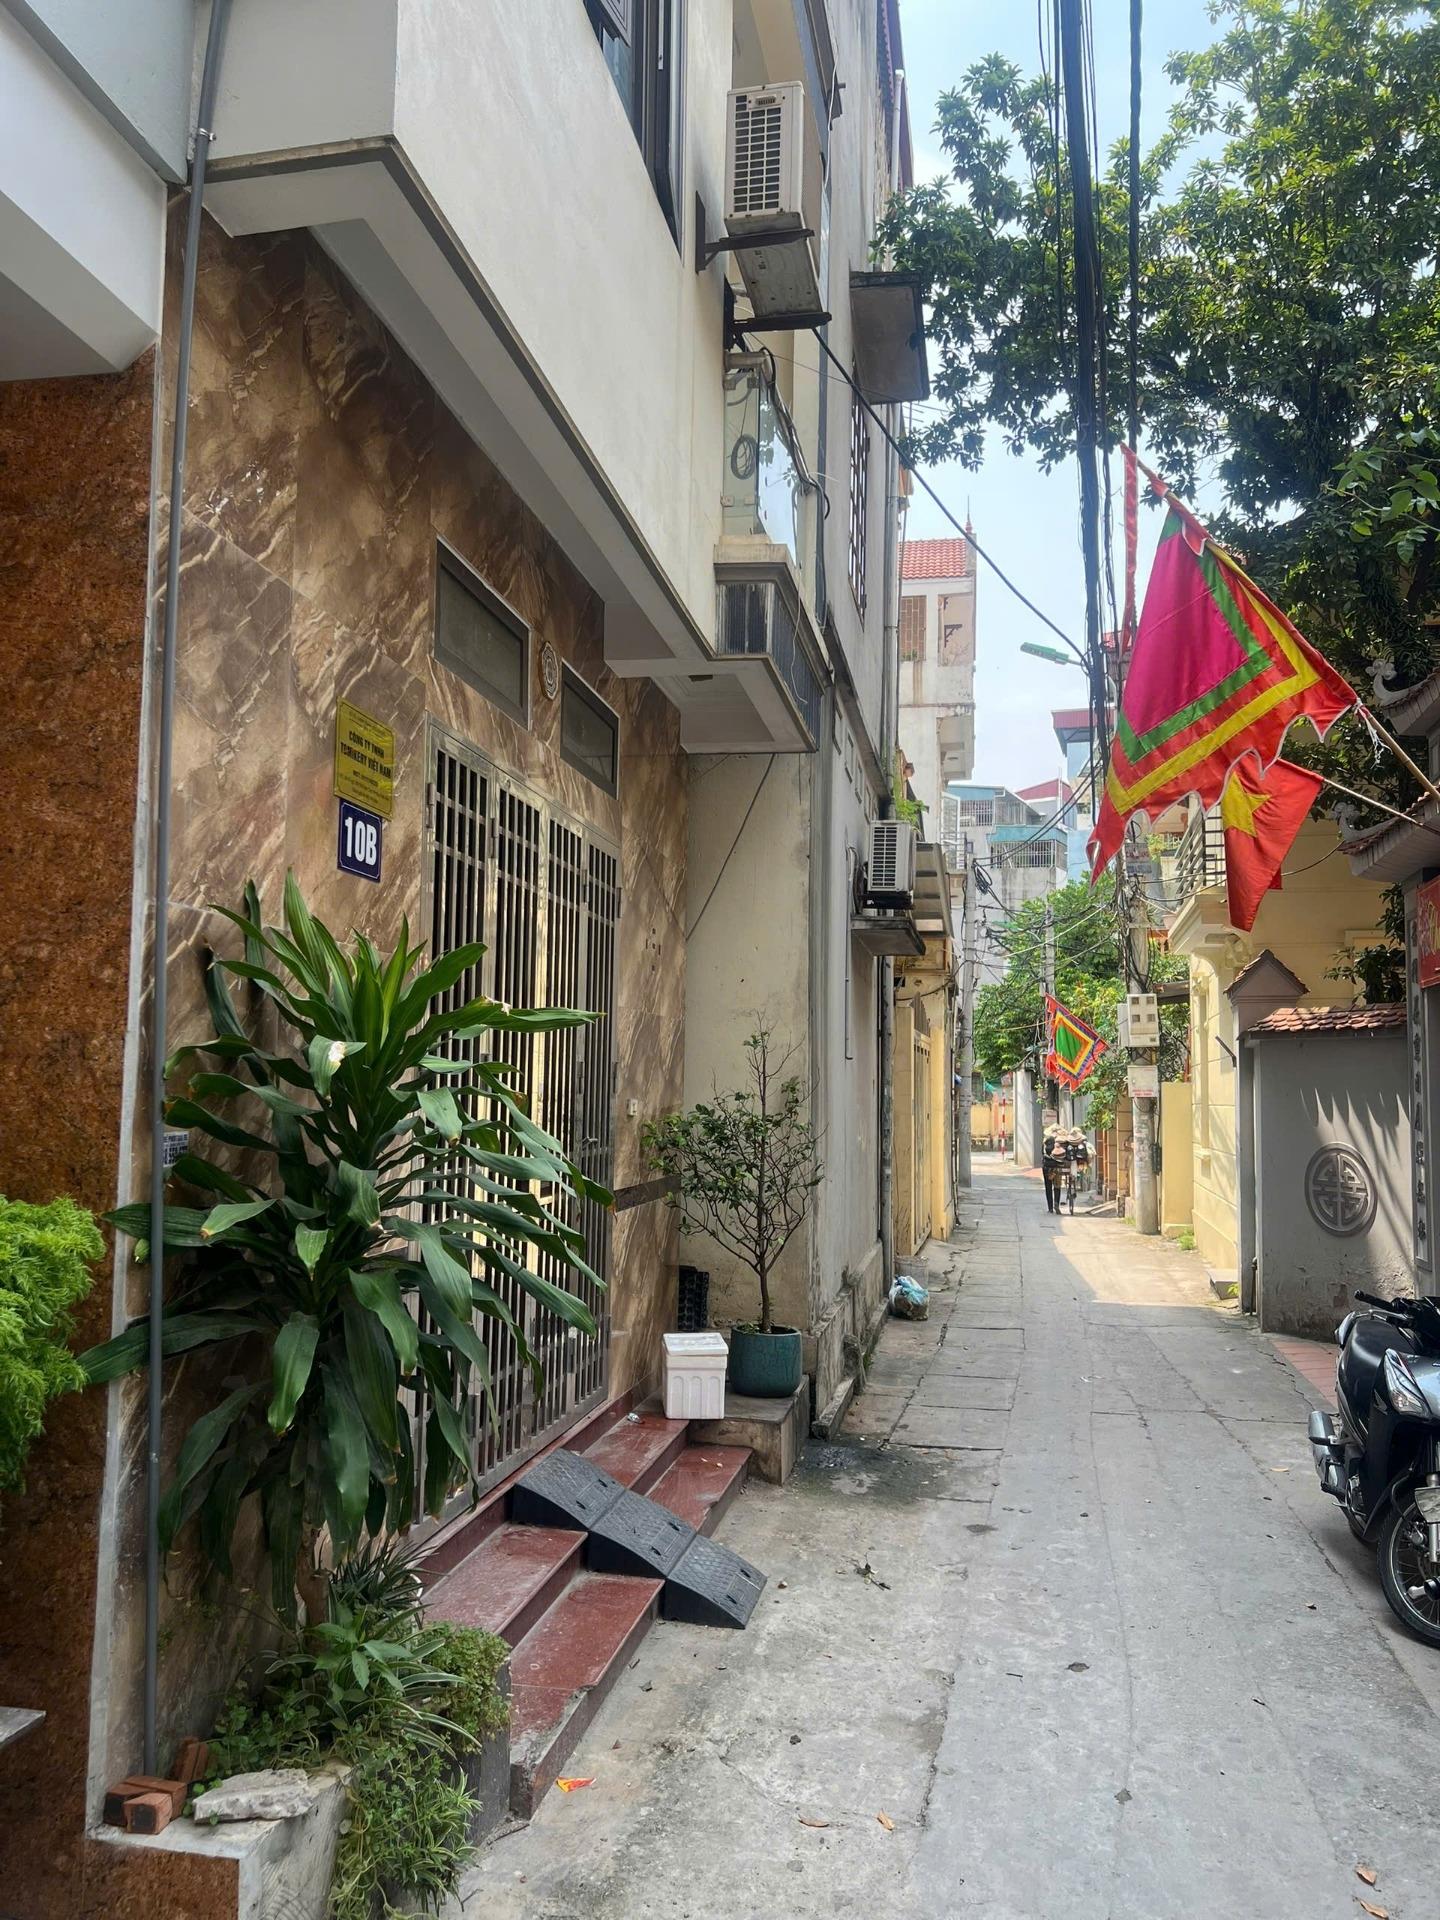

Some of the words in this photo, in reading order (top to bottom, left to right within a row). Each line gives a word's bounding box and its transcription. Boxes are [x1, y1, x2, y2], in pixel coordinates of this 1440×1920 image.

[349, 730, 364, 748] CÔNG
[364, 739, 371, 752] TY
[344, 816, 378, 866] 10B
